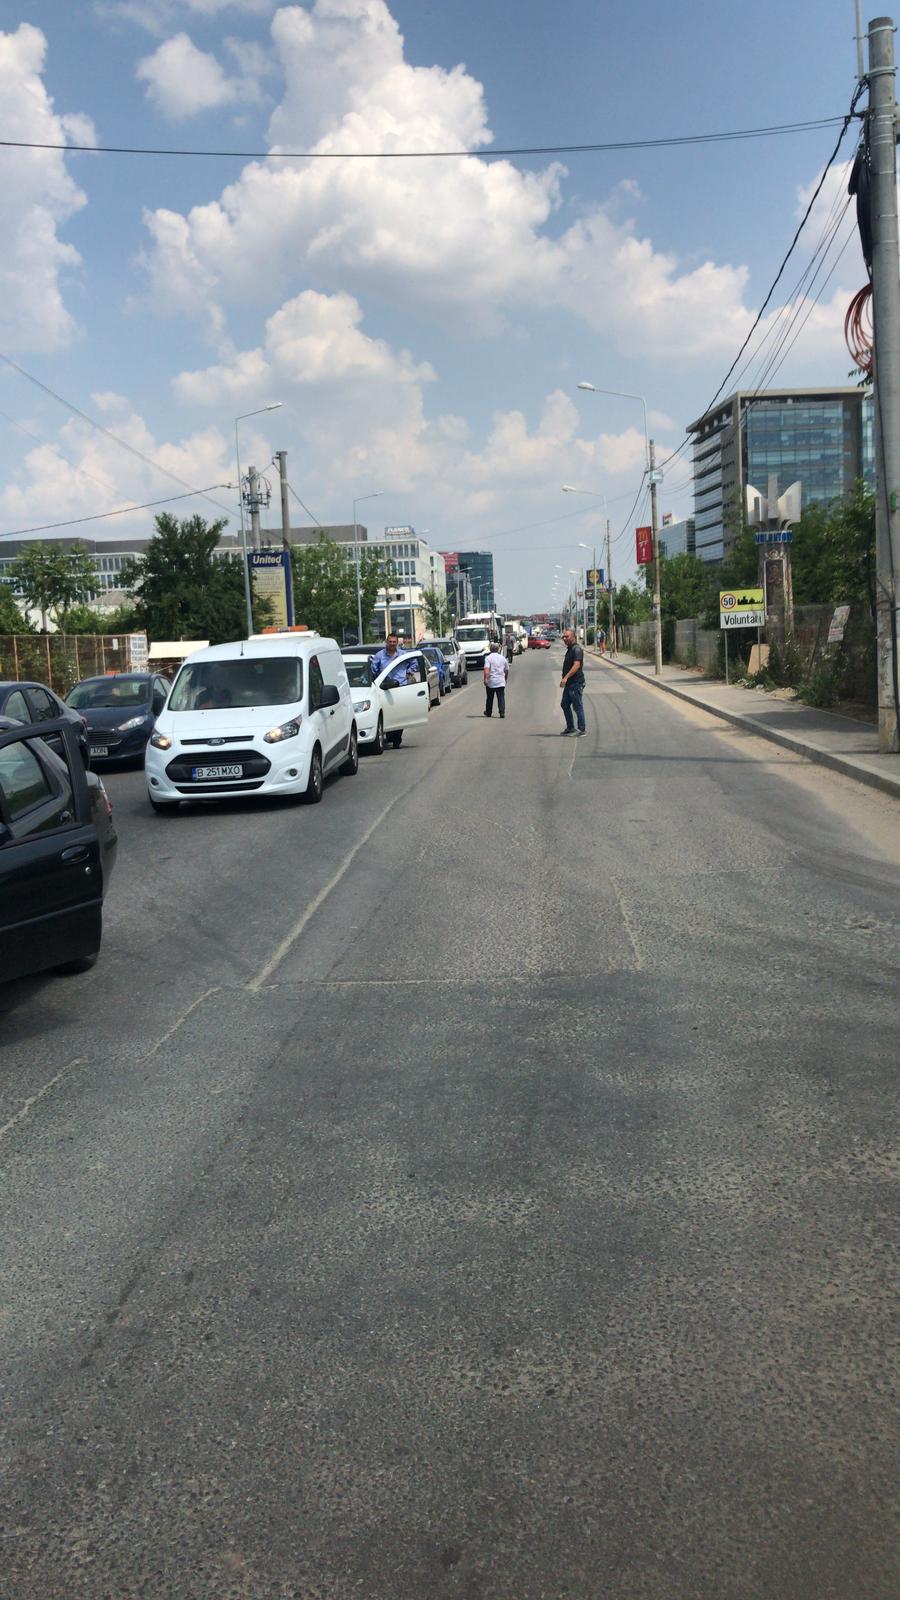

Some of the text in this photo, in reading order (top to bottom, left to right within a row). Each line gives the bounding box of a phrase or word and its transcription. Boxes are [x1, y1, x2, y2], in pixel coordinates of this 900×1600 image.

[252, 555, 282, 564] United
[723, 597, 733, 606] 50
[724, 614, 762, 625] Voluntari
[197, 769, 204, 777] B
